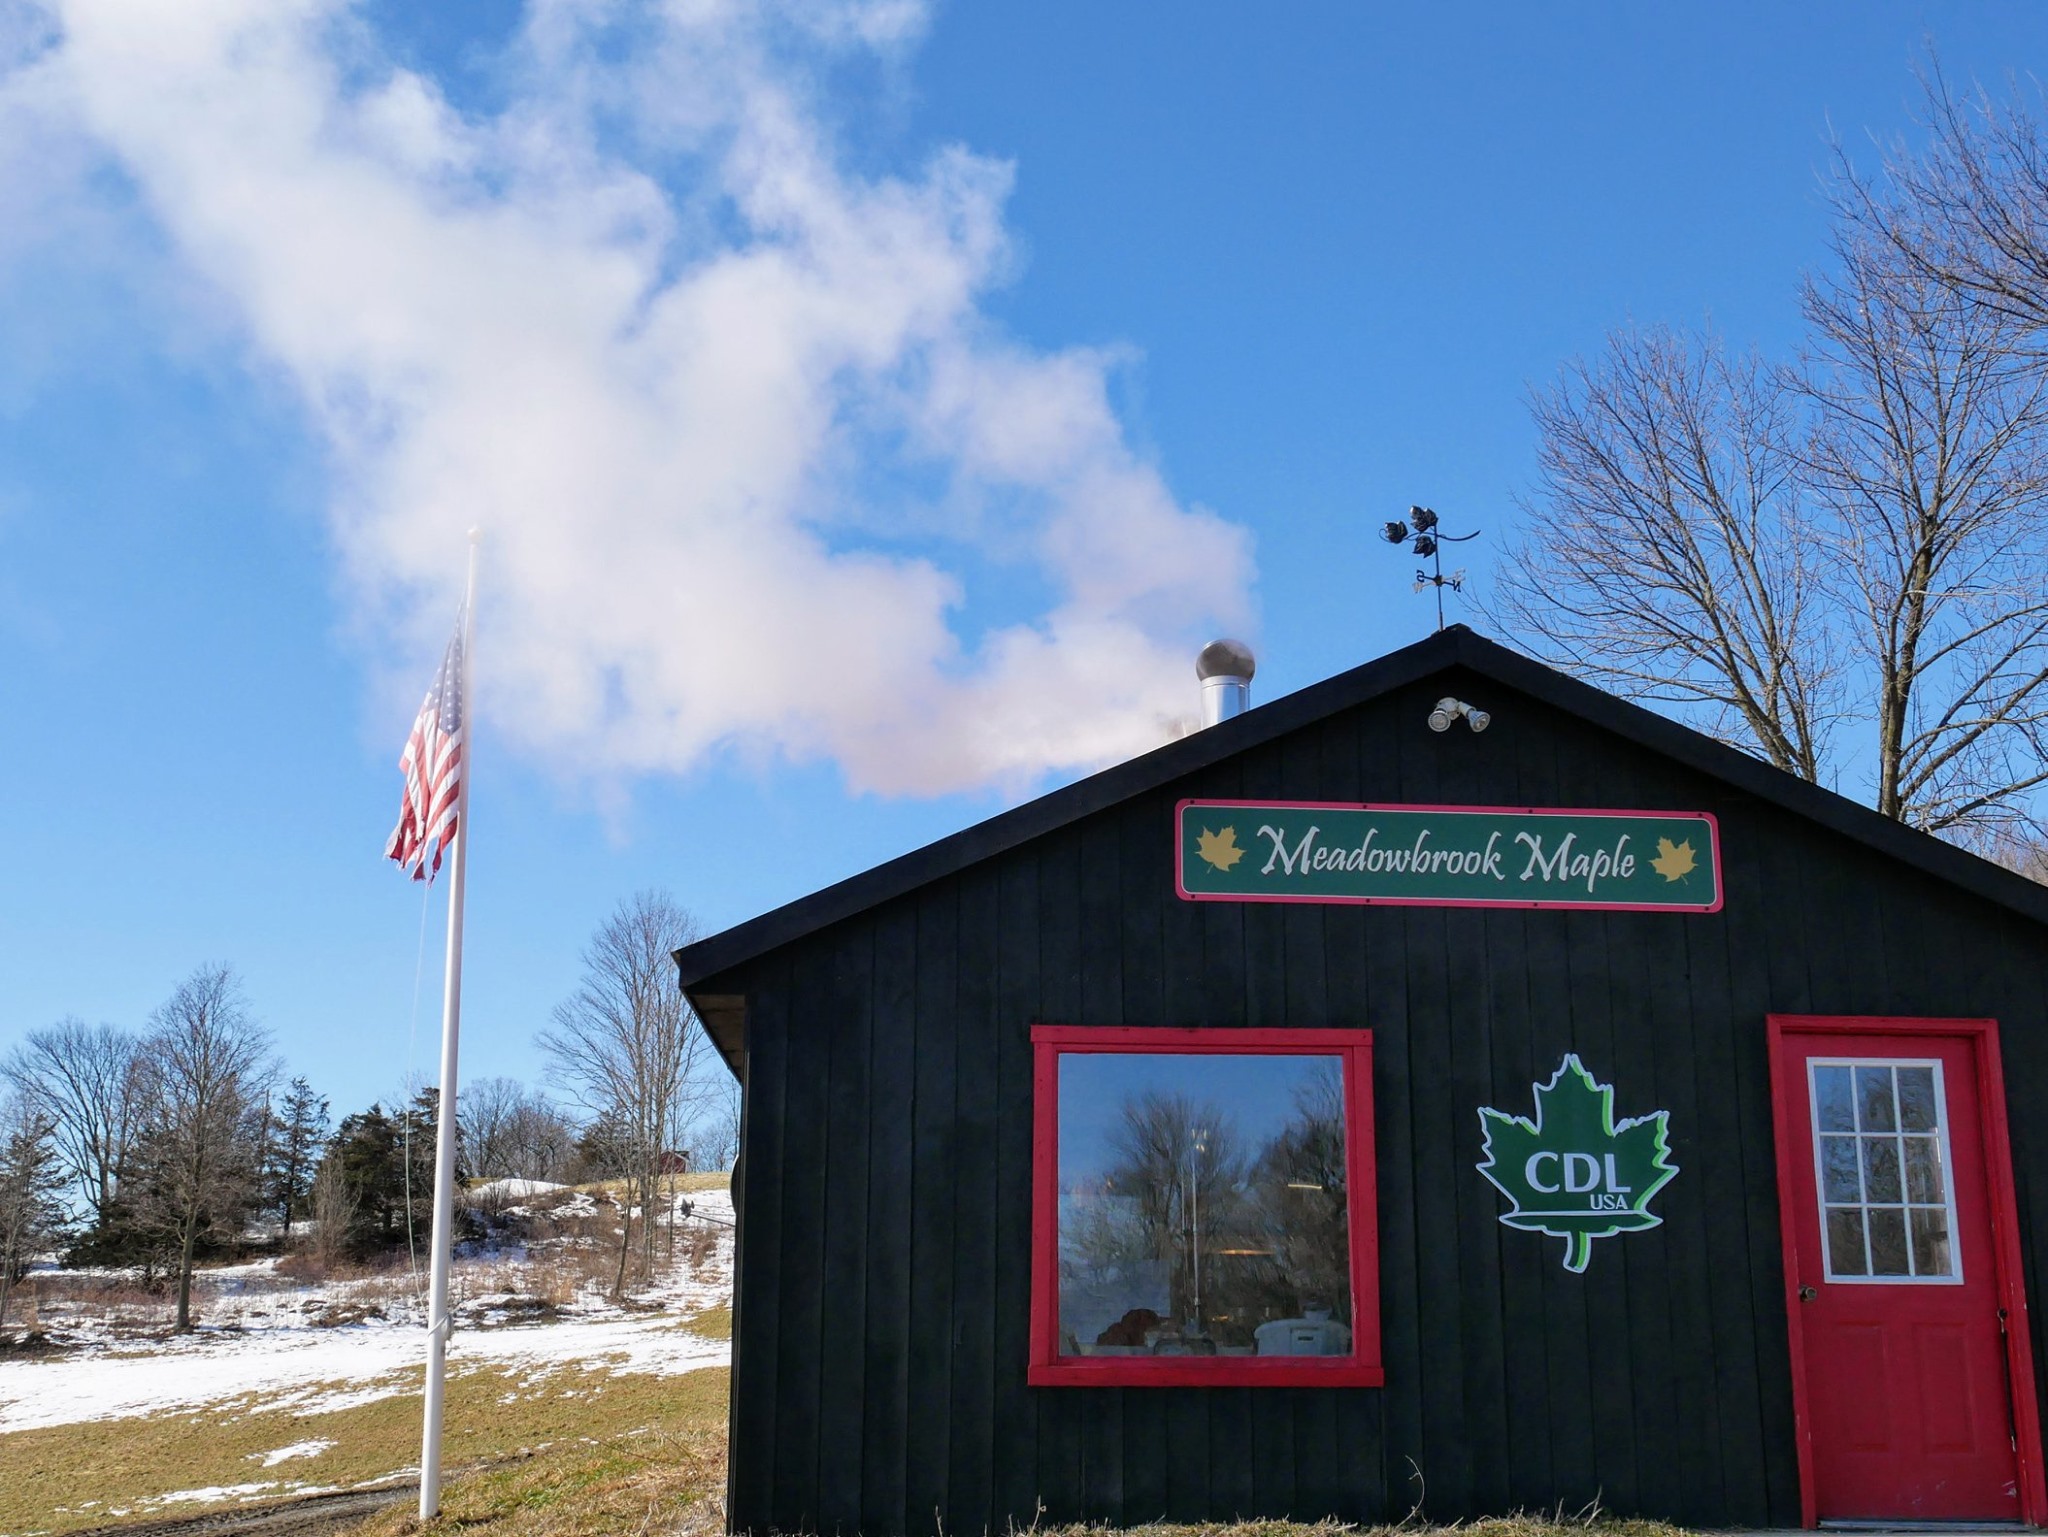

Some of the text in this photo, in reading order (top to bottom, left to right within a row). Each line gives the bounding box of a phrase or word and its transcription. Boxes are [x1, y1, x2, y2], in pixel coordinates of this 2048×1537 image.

[1256, 825, 1635, 892] Meadowbrook Maple
[1525, 1151, 1631, 1193] CDL
[1590, 1194, 1628, 1210] USA
